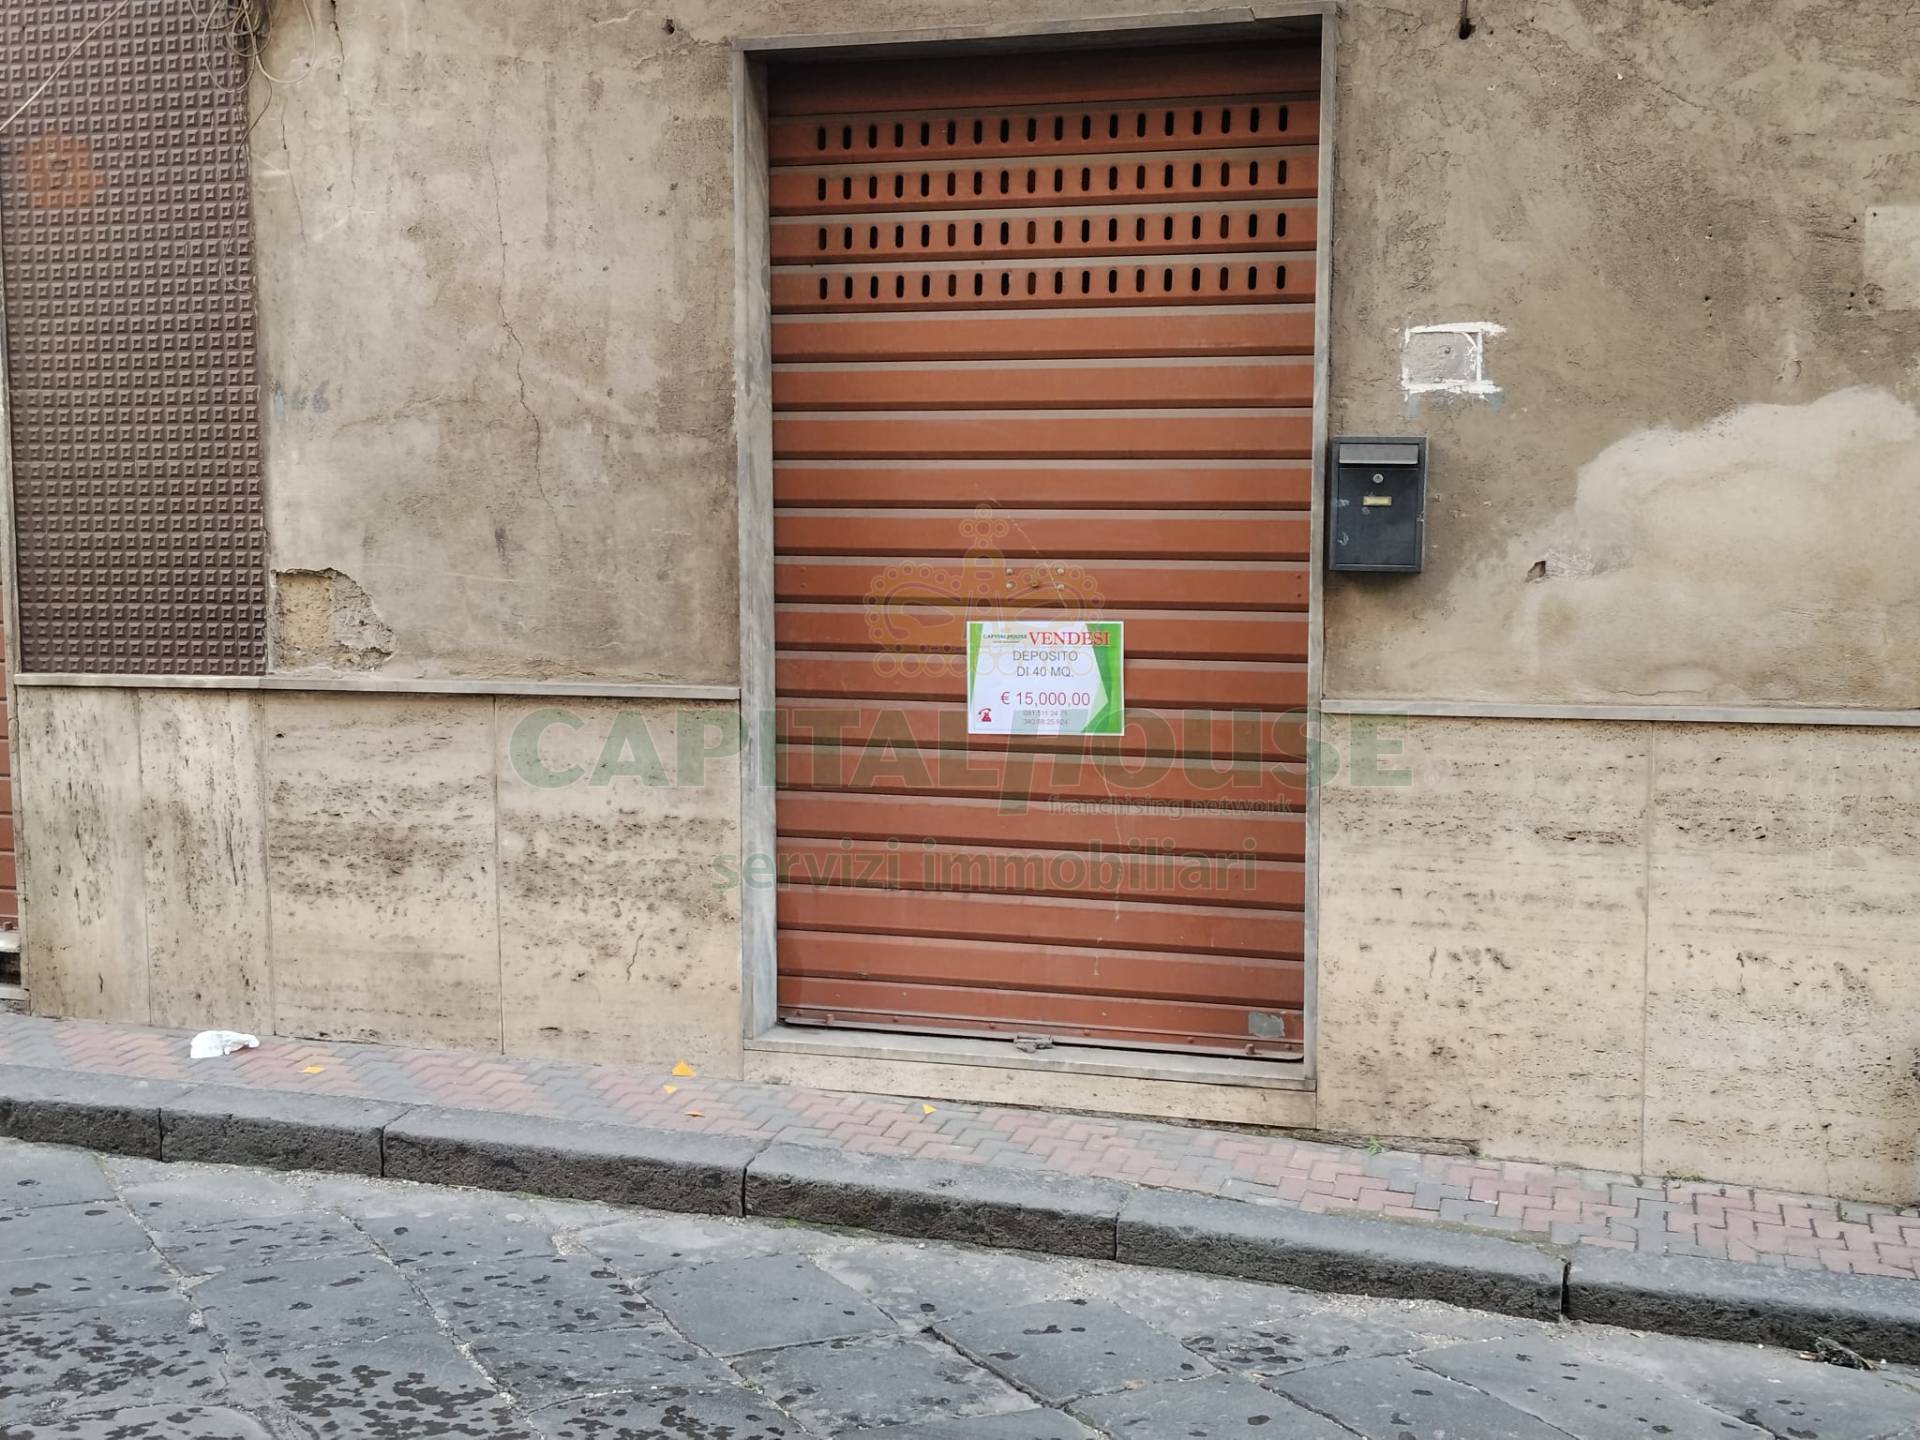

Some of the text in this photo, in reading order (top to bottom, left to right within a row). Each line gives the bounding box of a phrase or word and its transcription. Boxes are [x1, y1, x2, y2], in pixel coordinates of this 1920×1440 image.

[1029, 631, 1109, 645] VENDESI
[1012, 650, 1078, 662] DEPOSITO
[1016, 666, 1074, 678] DI 40 MQ.
[1000, 691, 1090, 707] € 15,000,00
